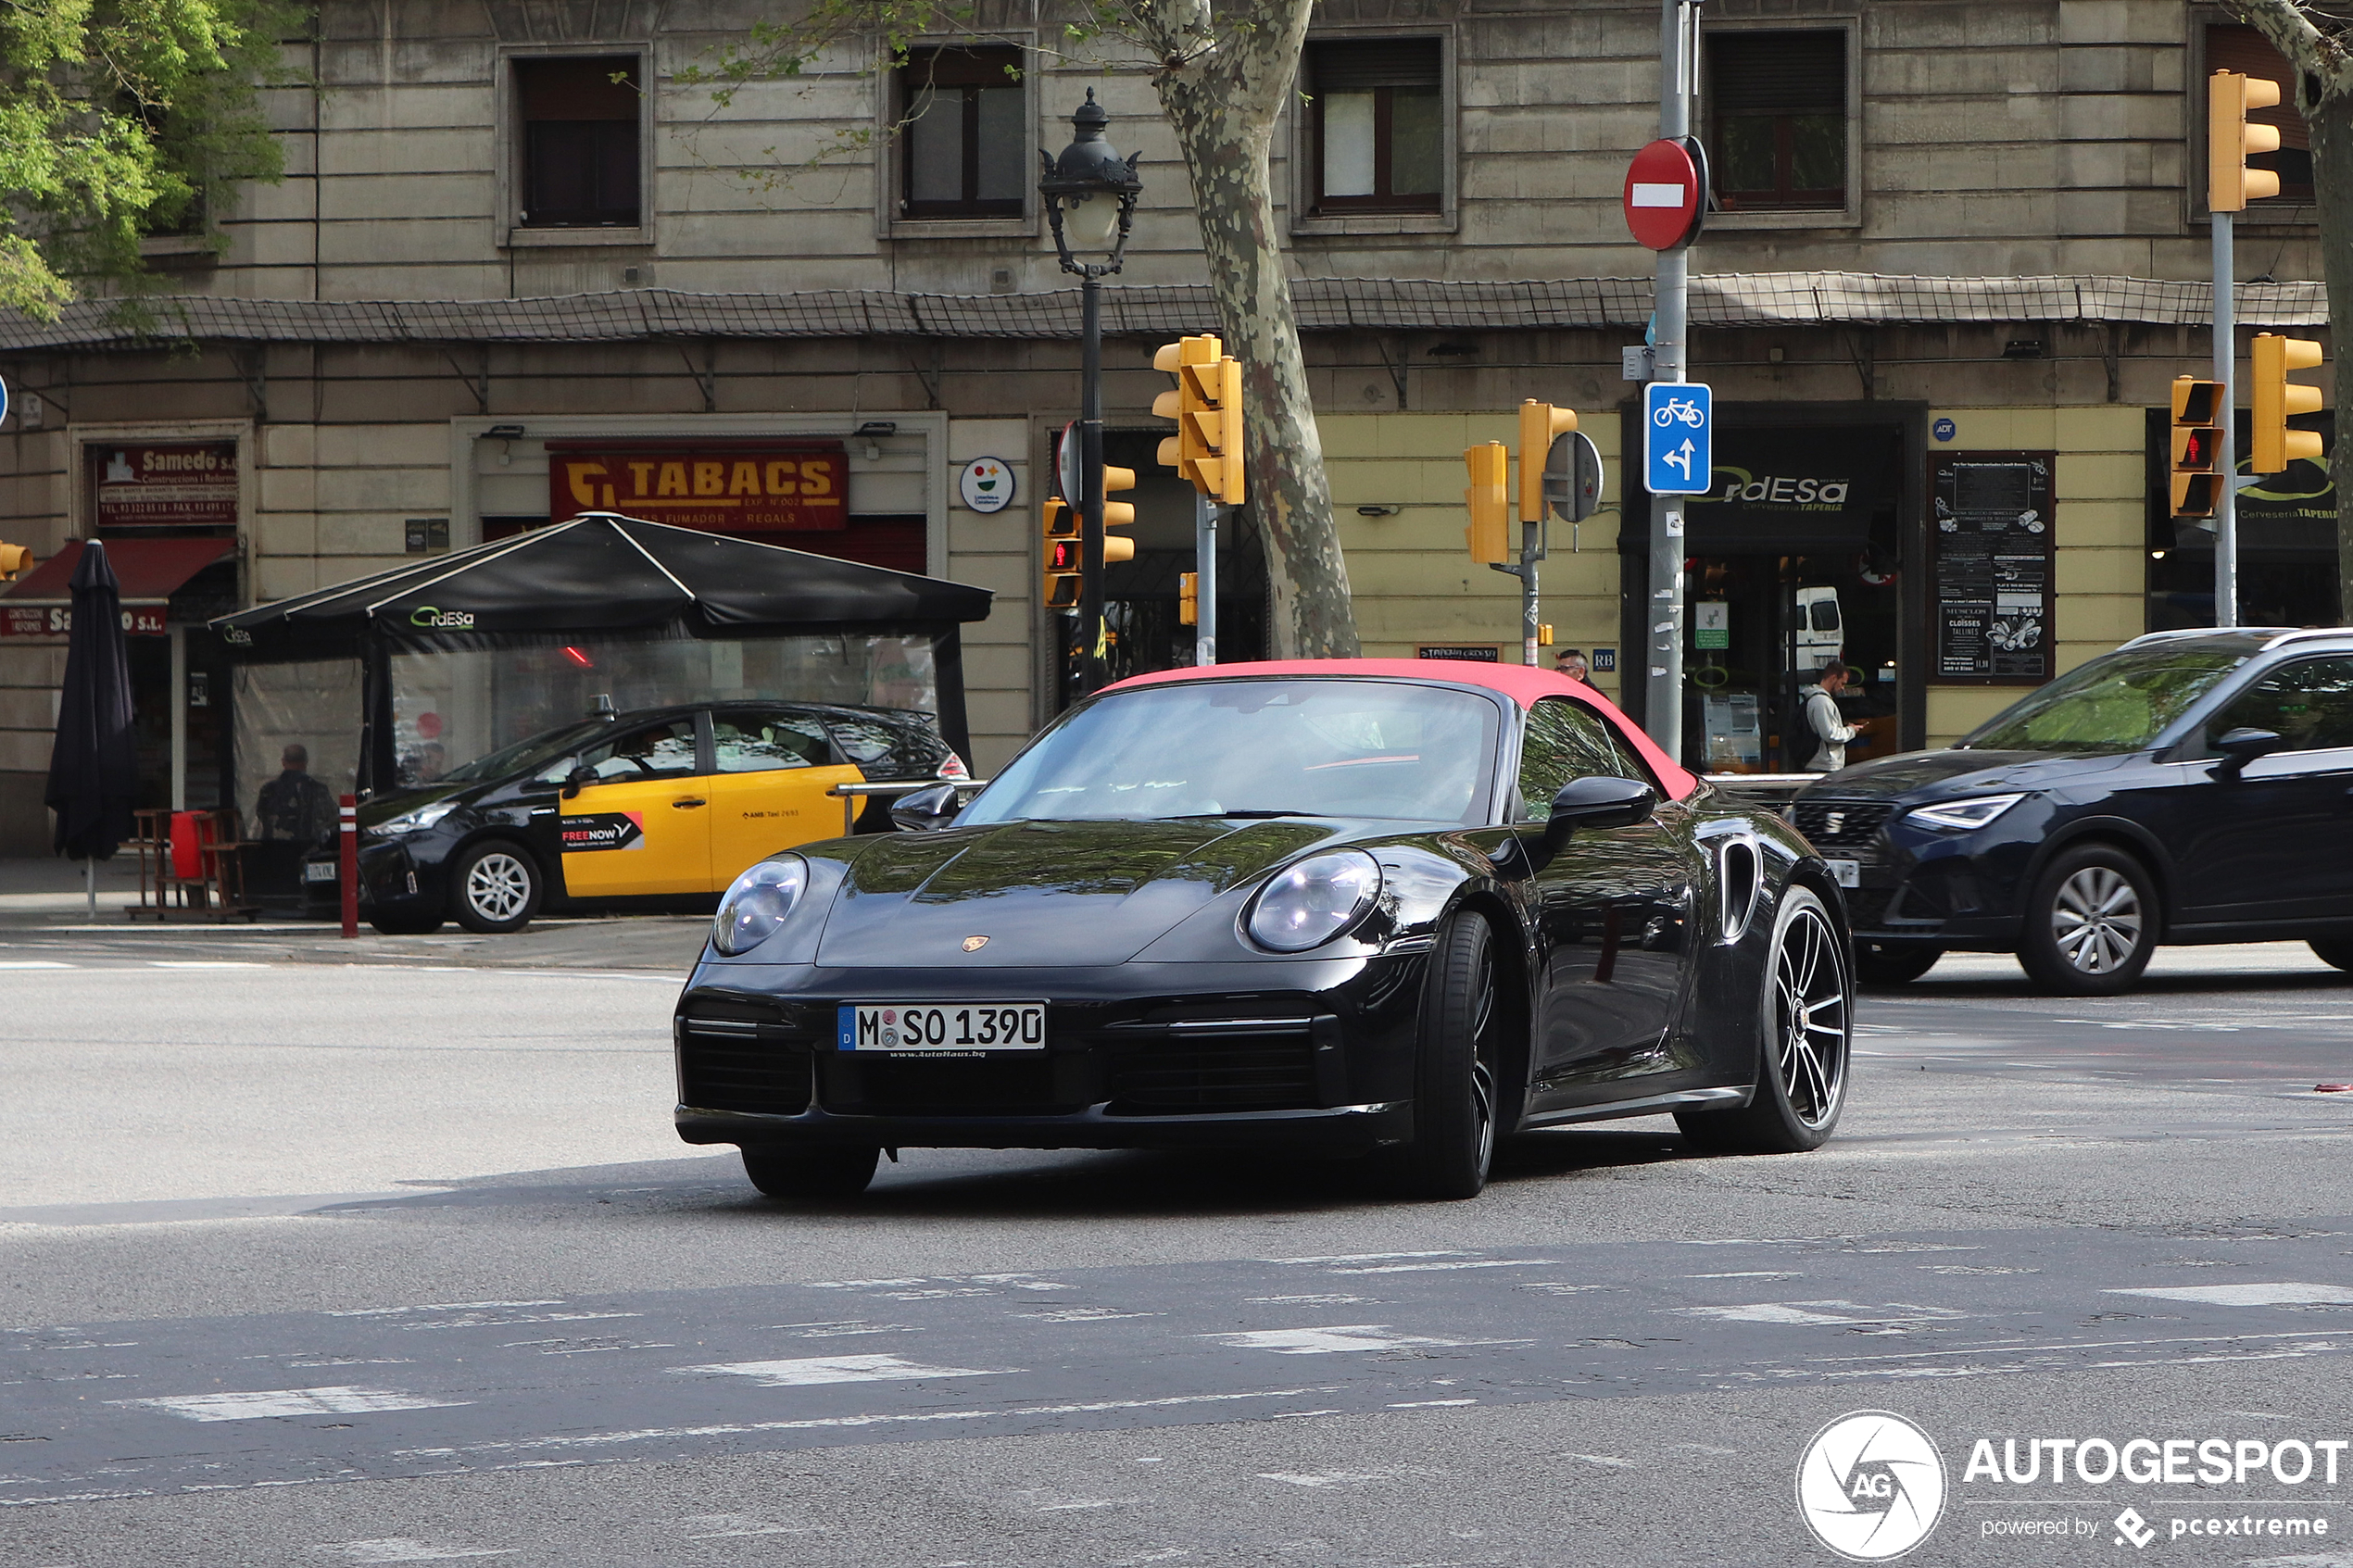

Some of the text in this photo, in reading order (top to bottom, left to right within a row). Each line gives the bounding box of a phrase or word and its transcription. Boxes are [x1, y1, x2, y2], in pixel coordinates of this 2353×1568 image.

[1937, 424, 1952, 433] ADT
[143, 450, 217, 470] Samedo
[142, 475, 198, 483] Construccions
[628, 462, 831, 495] TABACS
[745, 498, 765, 507] EXP.
[666, 515, 725, 524] FUMADOR
[747, 514, 795, 523] REGALS
[138, 616, 162, 631] S.L.
[1949, 619, 1981, 627] CLOÏSSES
[1595, 655, 1613, 666] RB
[562, 830, 615, 841] FREENOW
[860, 1010, 1041, 1046] M SO 1390
[844, 1034, 850, 1044] D
